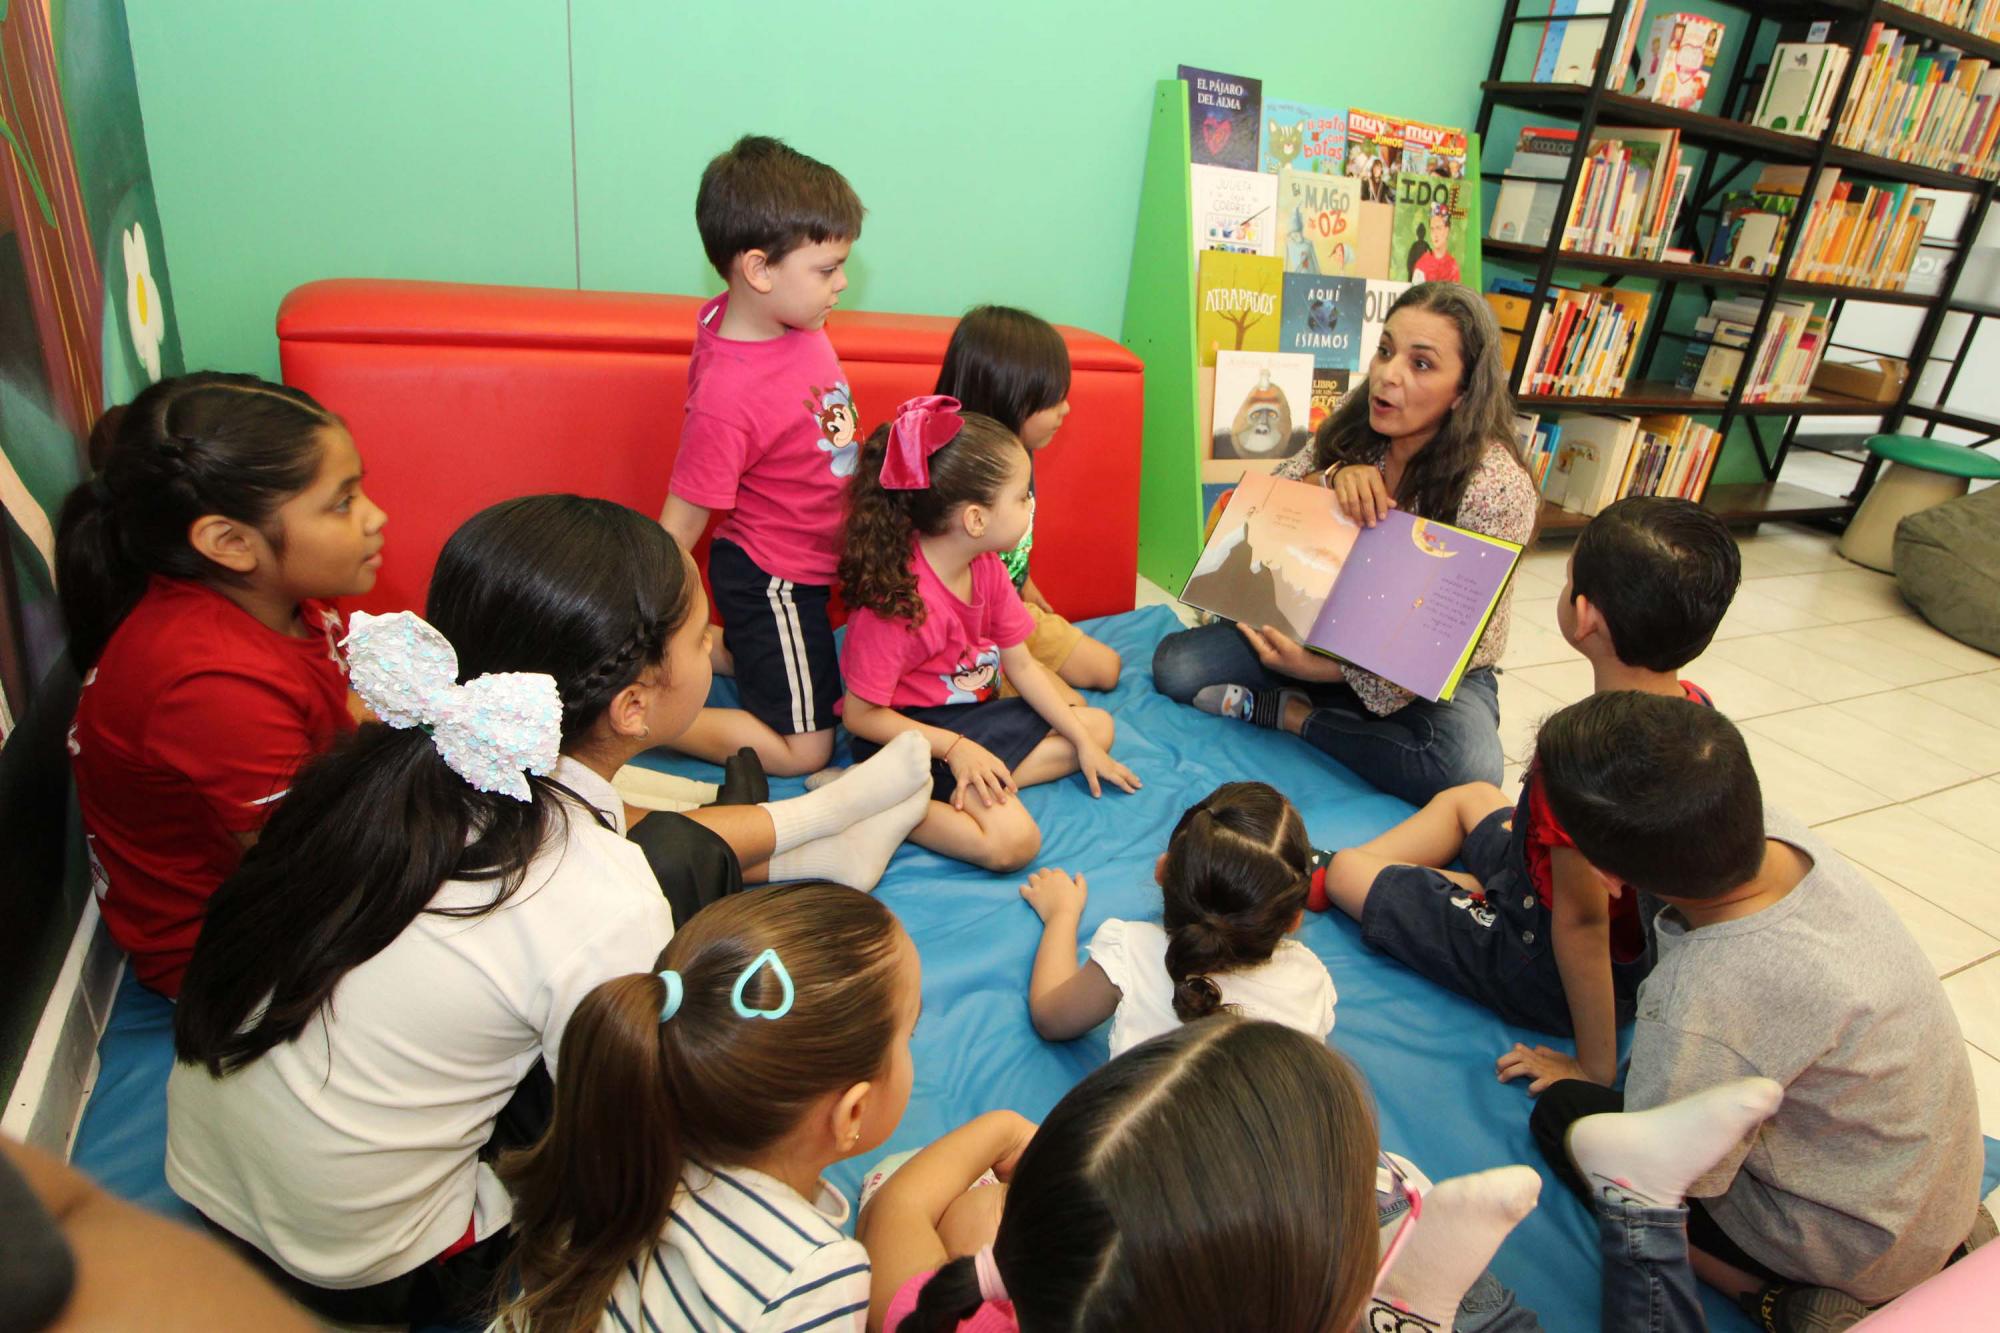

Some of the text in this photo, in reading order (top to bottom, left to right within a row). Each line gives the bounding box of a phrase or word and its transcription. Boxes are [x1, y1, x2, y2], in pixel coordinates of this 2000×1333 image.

[1197, 77, 1244, 97] EL PÁJARO
[1197, 92, 1241, 111] DEL ALMA
[1405, 124, 1446, 146] muy
[1305, 184, 1350, 213] MAGO
[1205, 287, 1277, 316] ATRAPADOS
[1295, 332, 1349, 350] ESTAMOS
